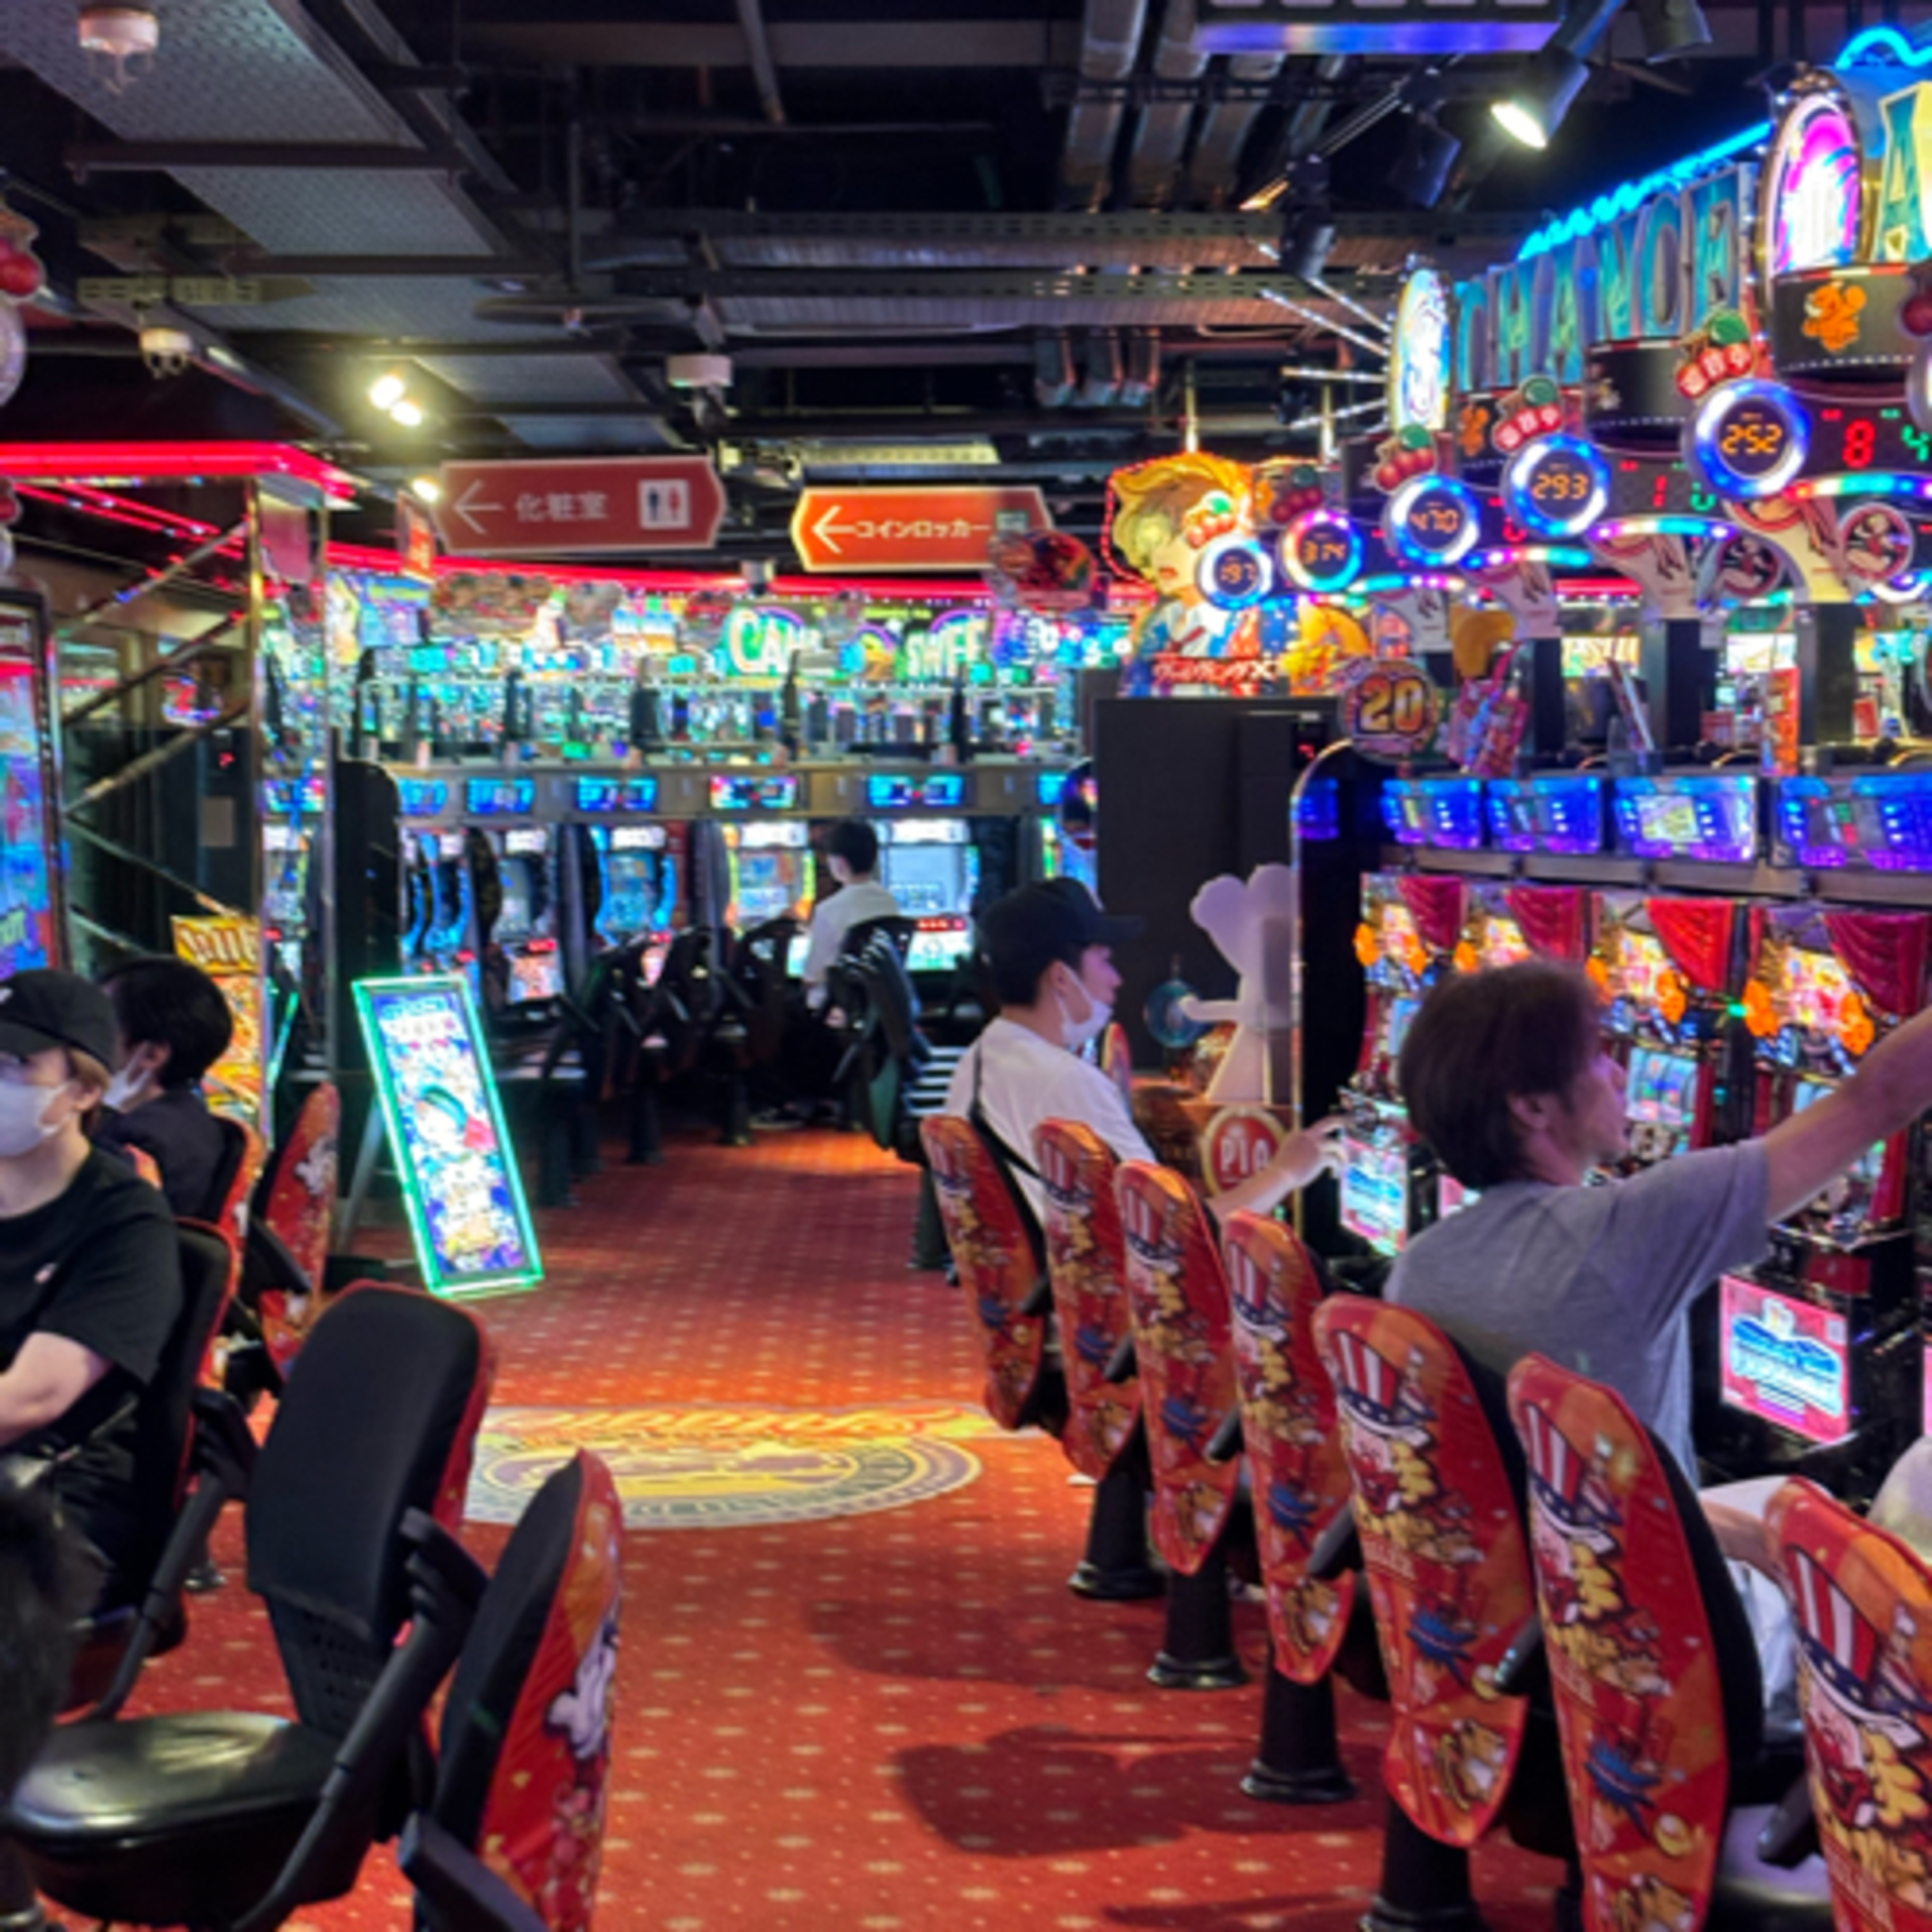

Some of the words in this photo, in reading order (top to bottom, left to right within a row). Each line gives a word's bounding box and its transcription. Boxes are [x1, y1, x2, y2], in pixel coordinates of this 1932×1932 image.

[1721, 424, 1783, 456] 252
[1842, 419, 1875, 469] 8
[1533, 472, 1589, 499] 293
[515, 492, 608, 522] 化粧室
[855, 518, 990, 539] コインロッカー
[1359, 678, 1424, 733] 20
